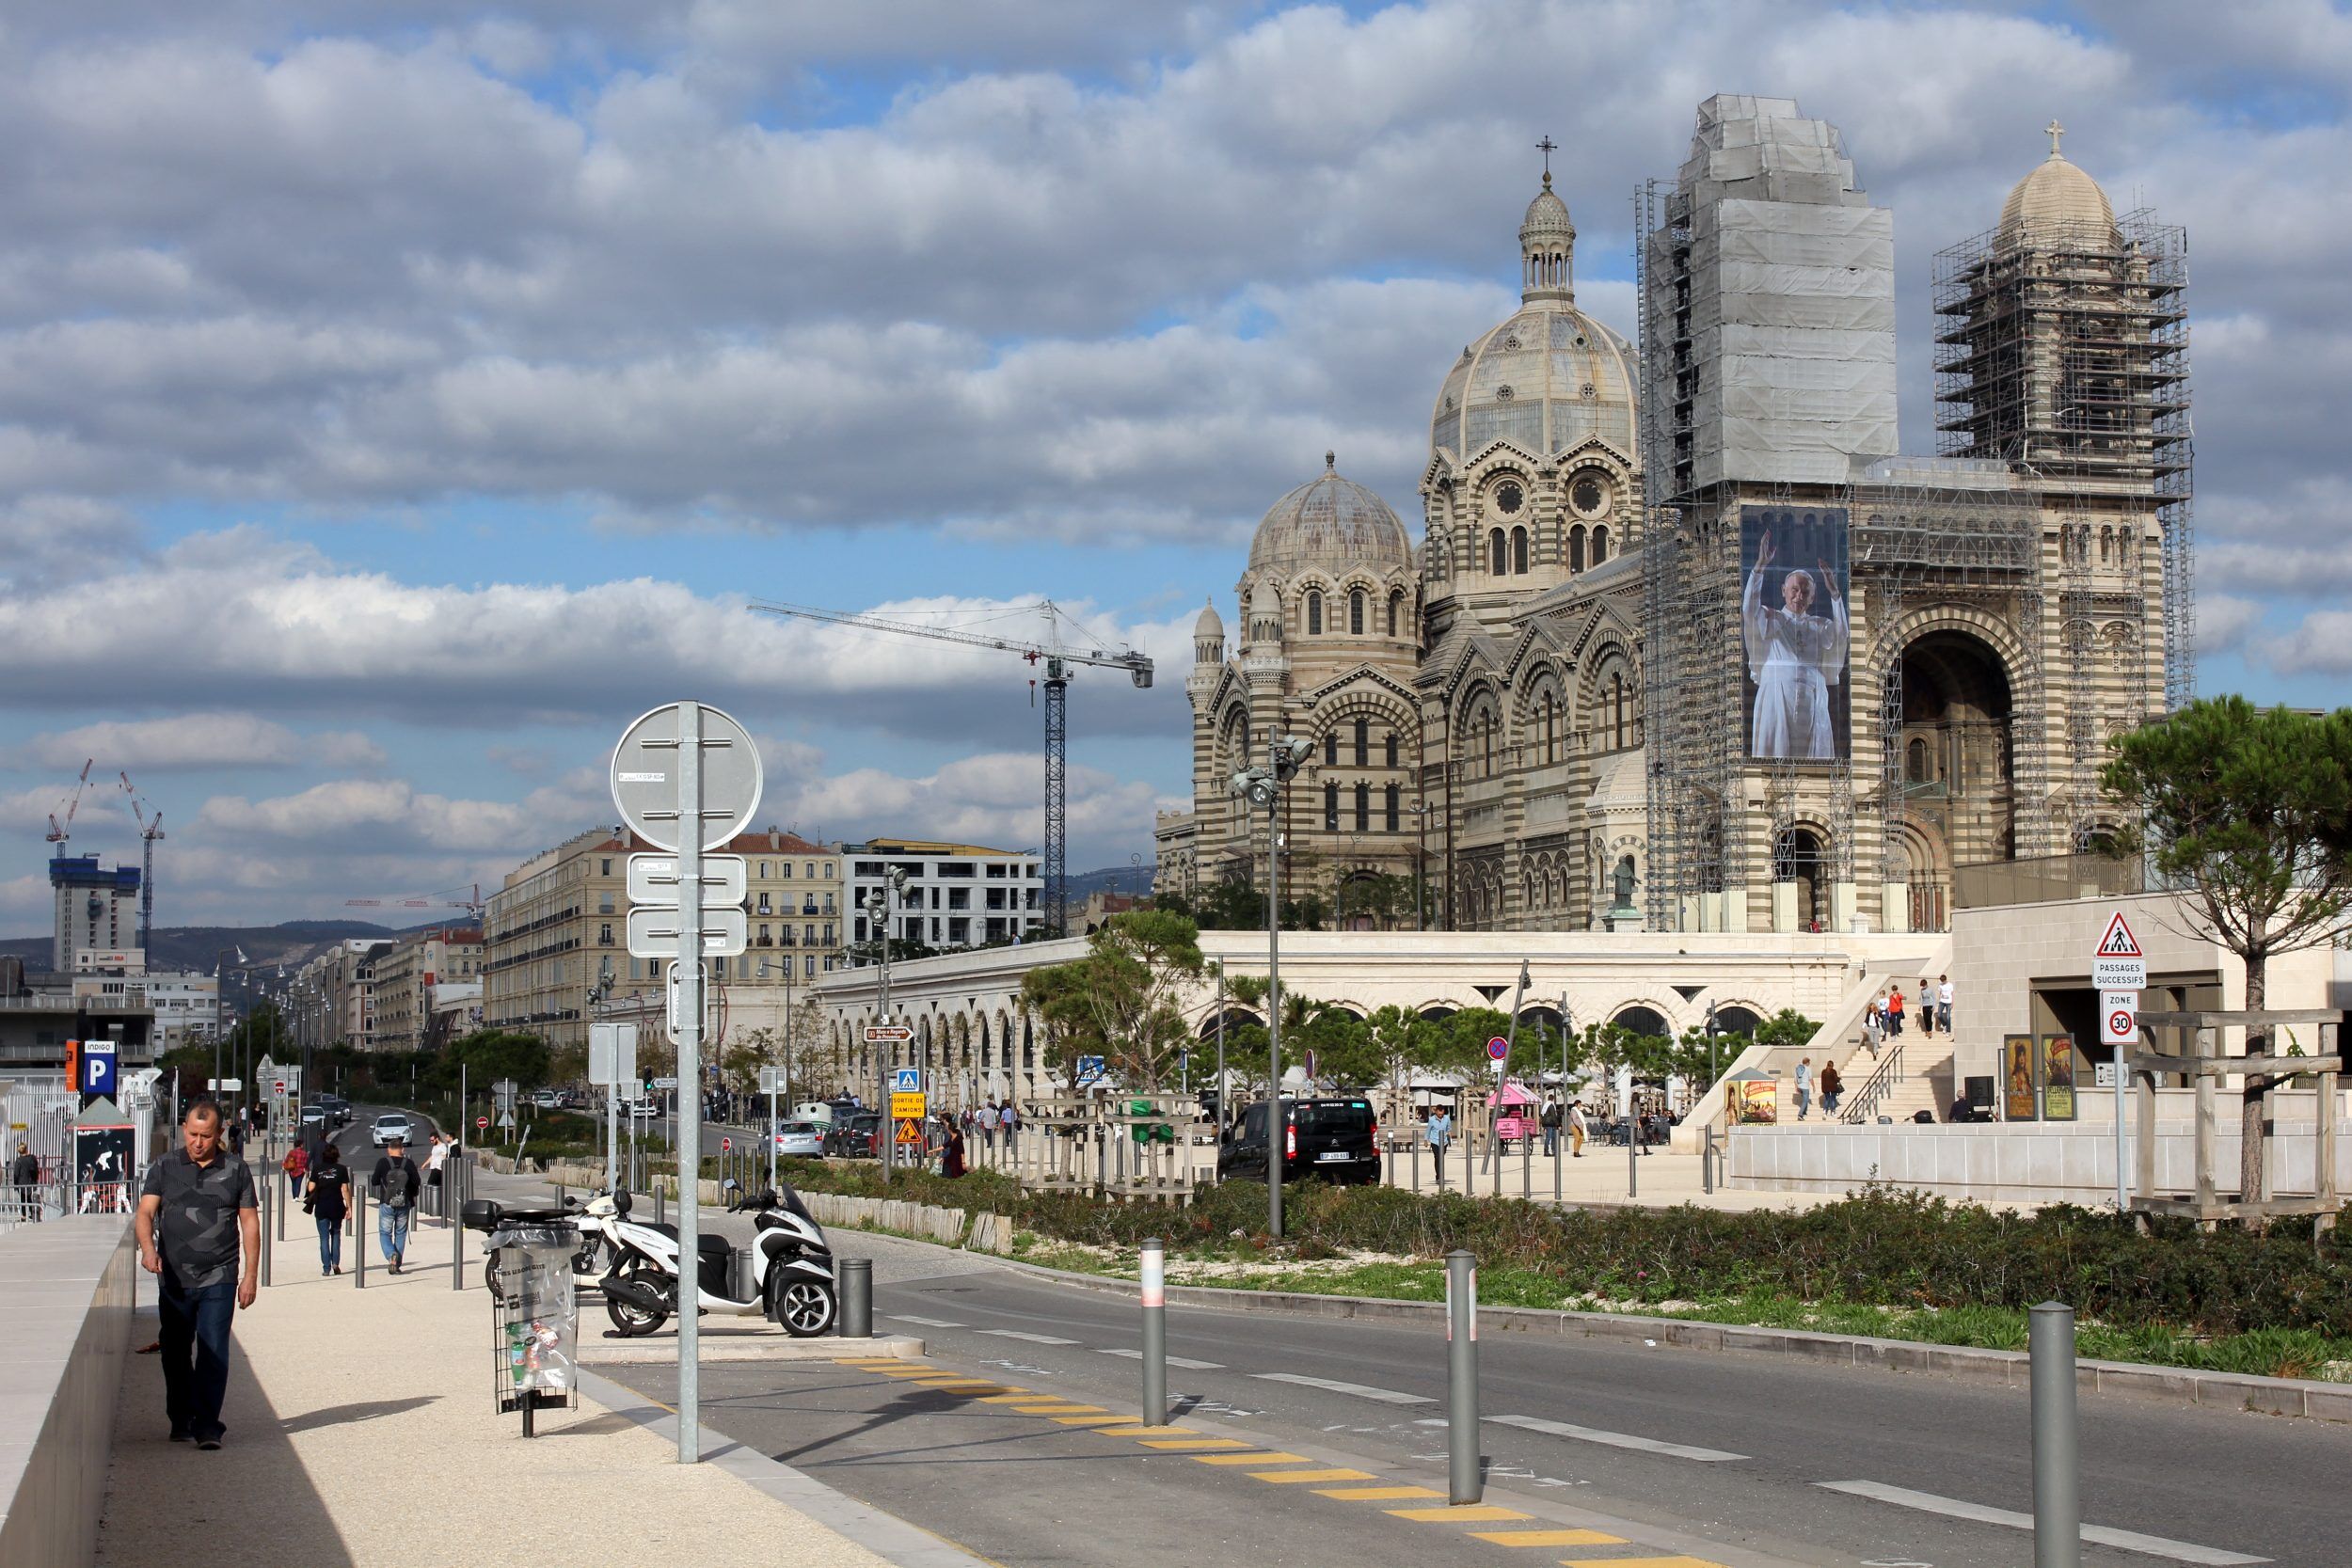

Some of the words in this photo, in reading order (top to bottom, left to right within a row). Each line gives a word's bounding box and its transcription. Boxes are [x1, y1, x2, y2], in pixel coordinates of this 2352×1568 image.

[2097, 975, 2144, 984] SUCCESSIFS
[2114, 1017, 2128, 1029] 30
[89, 1059, 106, 1086] P
